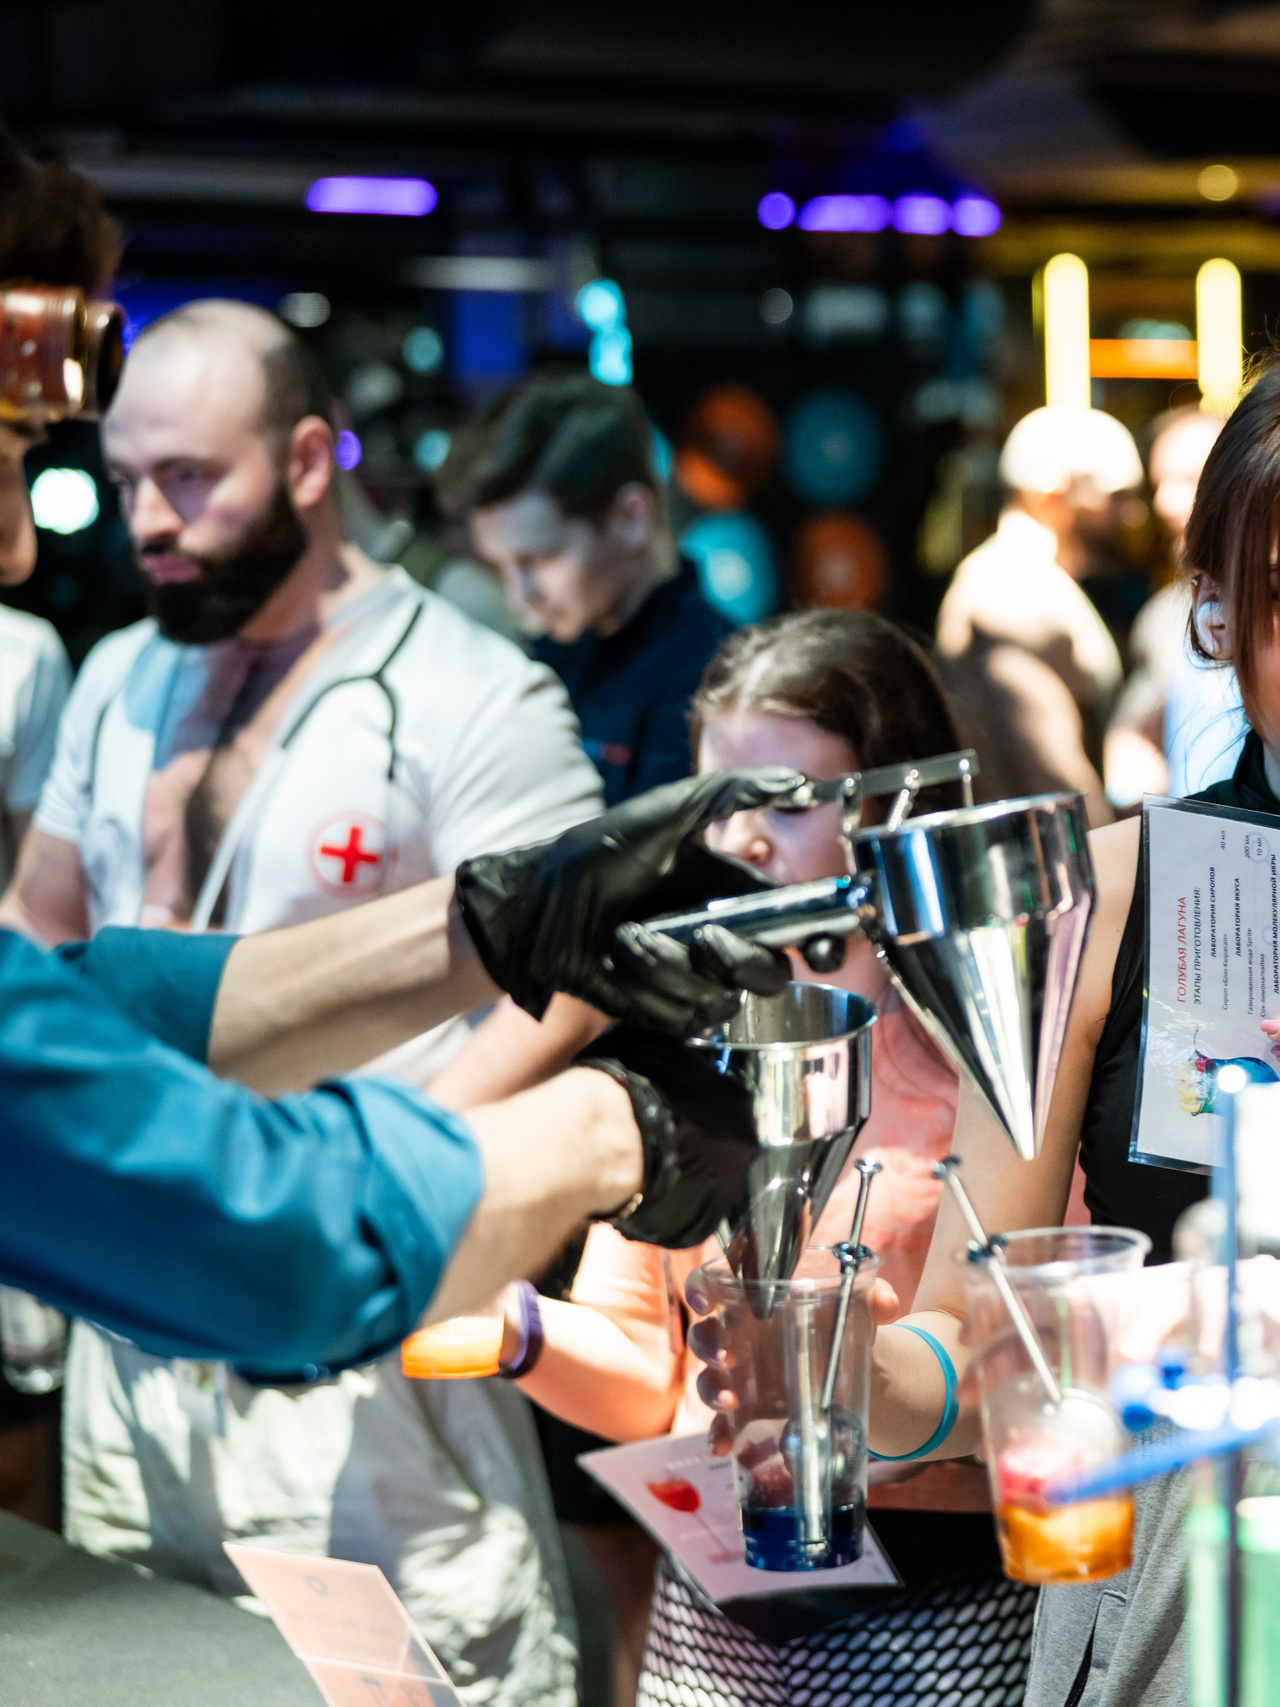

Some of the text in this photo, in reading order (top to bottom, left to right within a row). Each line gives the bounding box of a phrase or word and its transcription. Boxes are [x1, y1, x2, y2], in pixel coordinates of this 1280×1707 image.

[1220, 830, 1226, 840] мл
[1245, 834, 1250, 845] мл
[1257, 837, 1262, 848] мл
[1220, 841, 1226, 850] 40
[1256, 848, 1262, 856] 10
[1270, 877, 1279, 940] МОЛЕКУЛЯРНОЙ
[1246, 927, 1254, 948] Sprite
[1177, 896, 1187, 1003] ГОЛУБАЯ ЛАГУНА
[1193, 887, 1202, 1005] ЭТАПЫ ПРИГОТОВЛЕНИЯ:
[1258, 953, 1266, 1004] лимона/лайма
